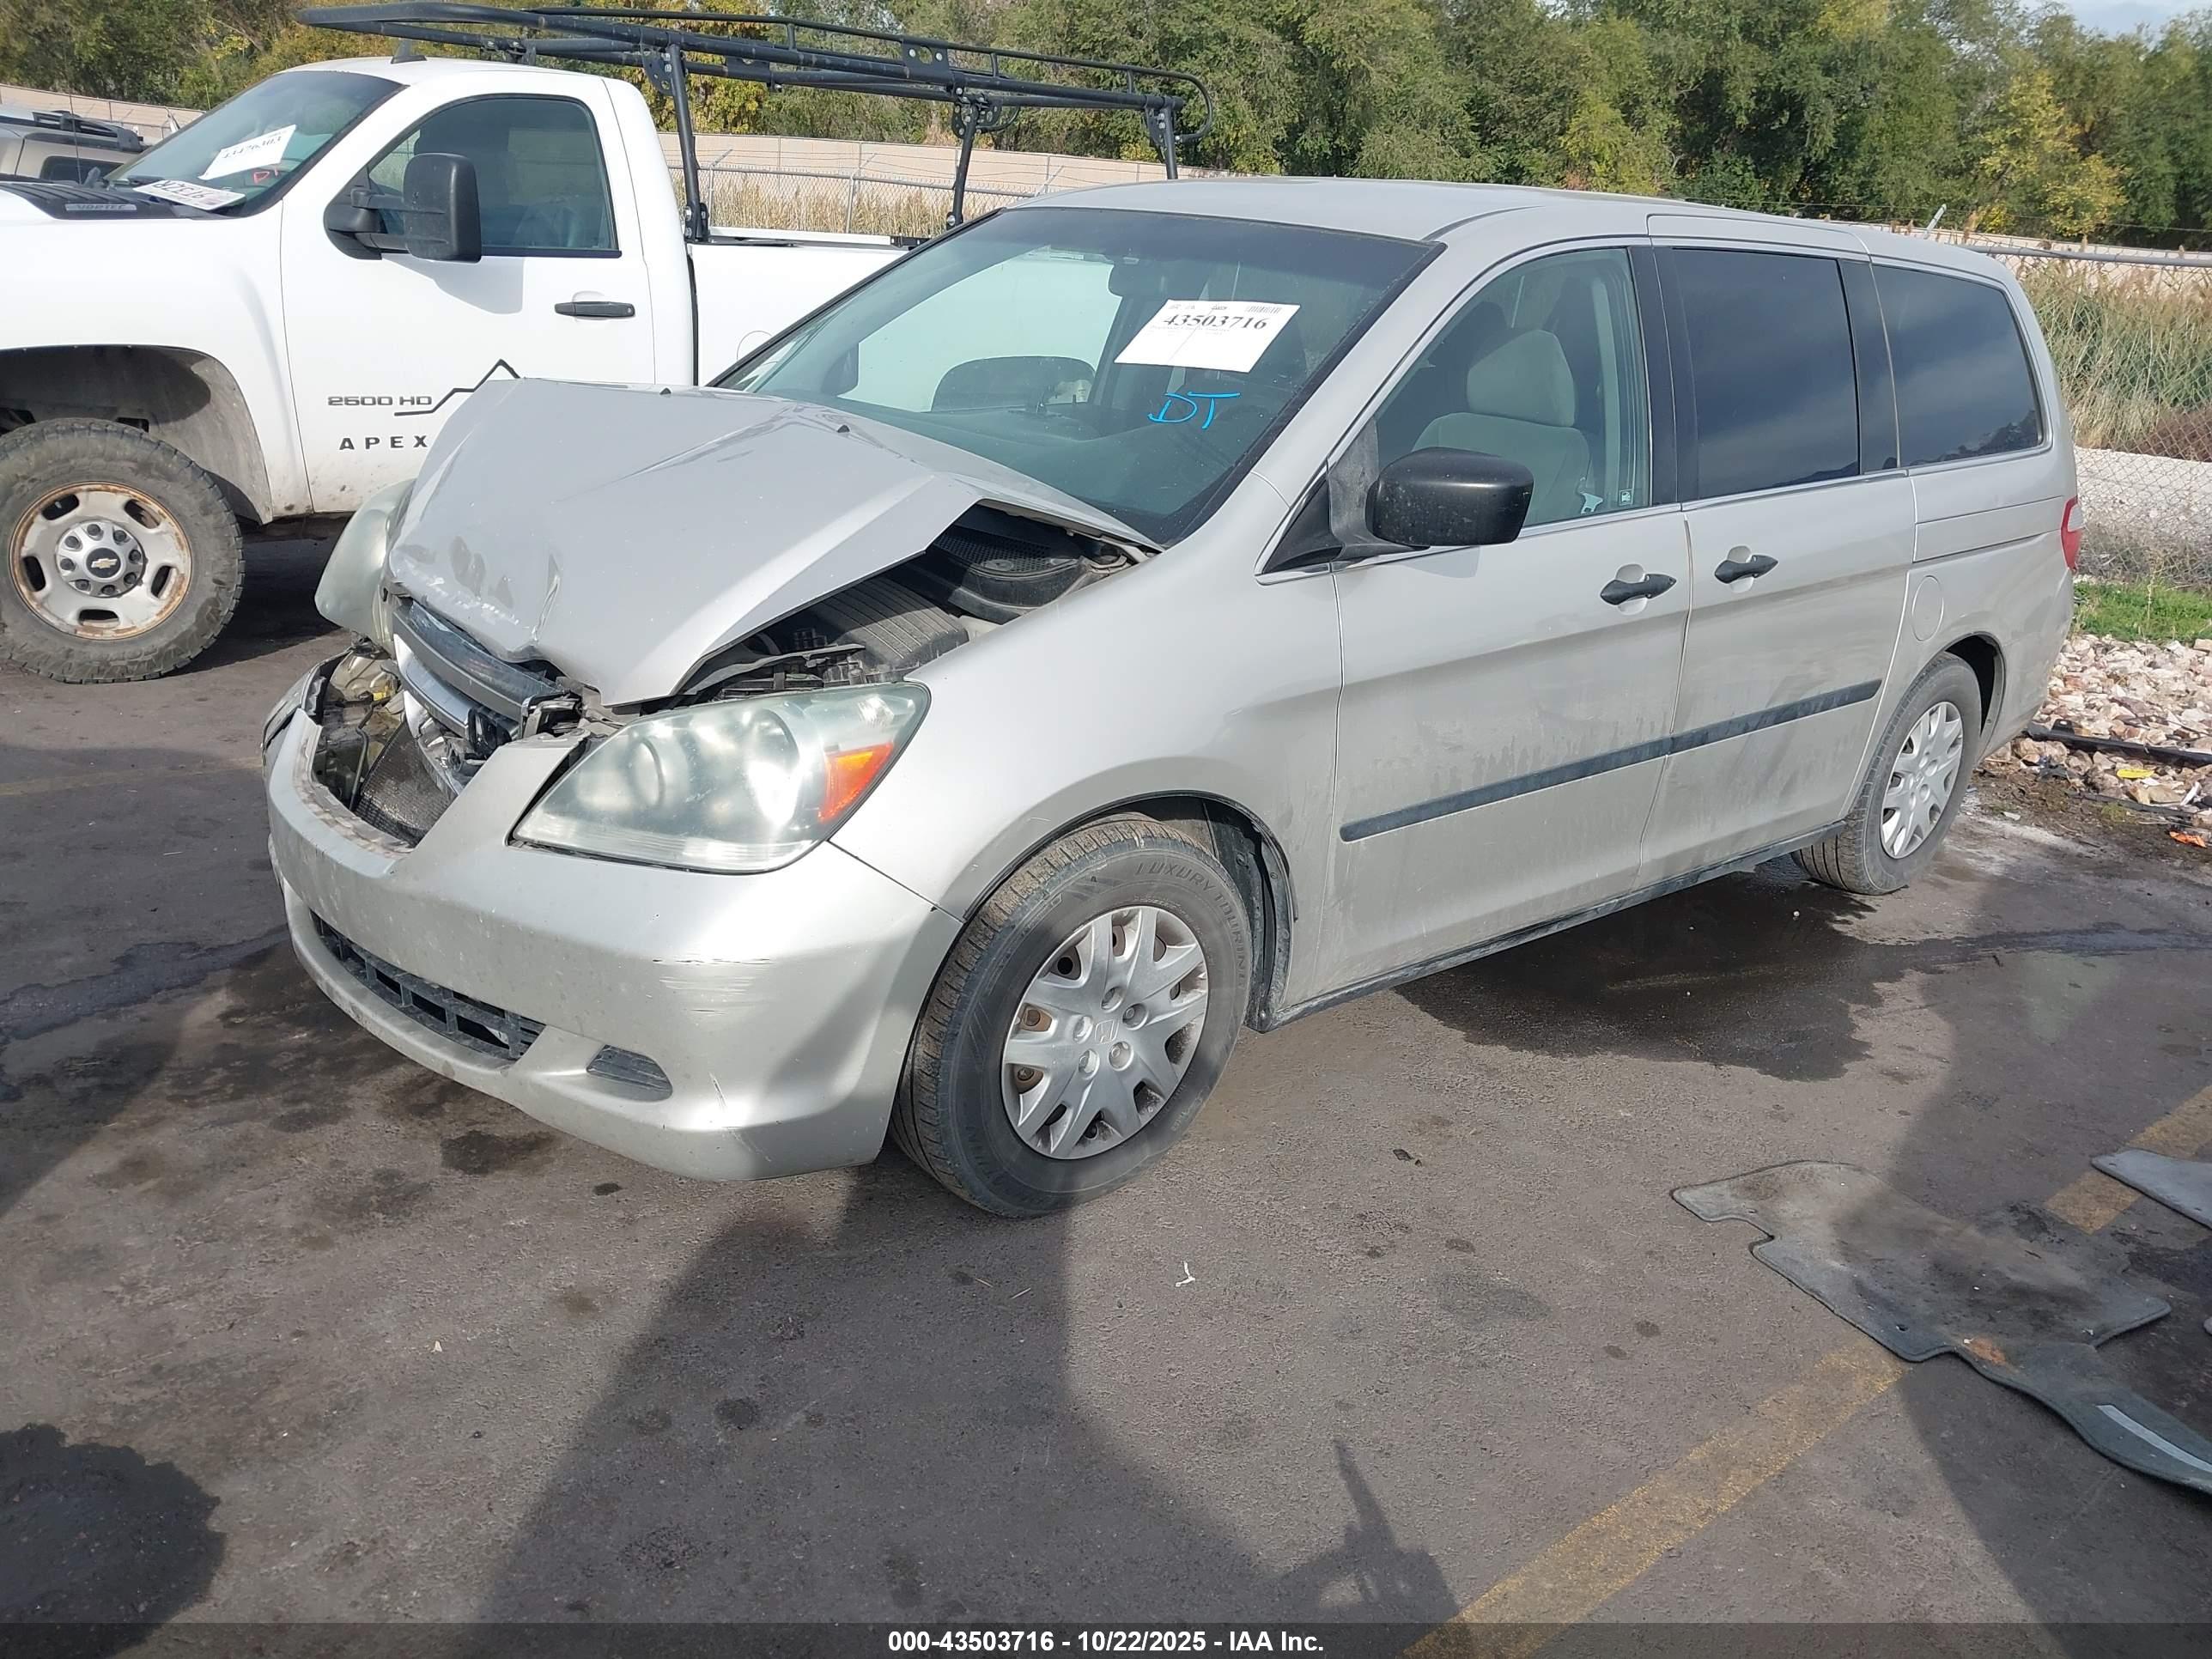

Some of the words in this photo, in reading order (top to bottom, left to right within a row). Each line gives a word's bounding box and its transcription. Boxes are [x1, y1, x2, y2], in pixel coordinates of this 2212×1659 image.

[1164, 313, 1269, 331] 43503716
[327, 395, 393, 406] 2500
[398, 395, 433, 406] HD
[1147, 391, 1241, 430] DT
[338, 434, 428, 451] APEX
